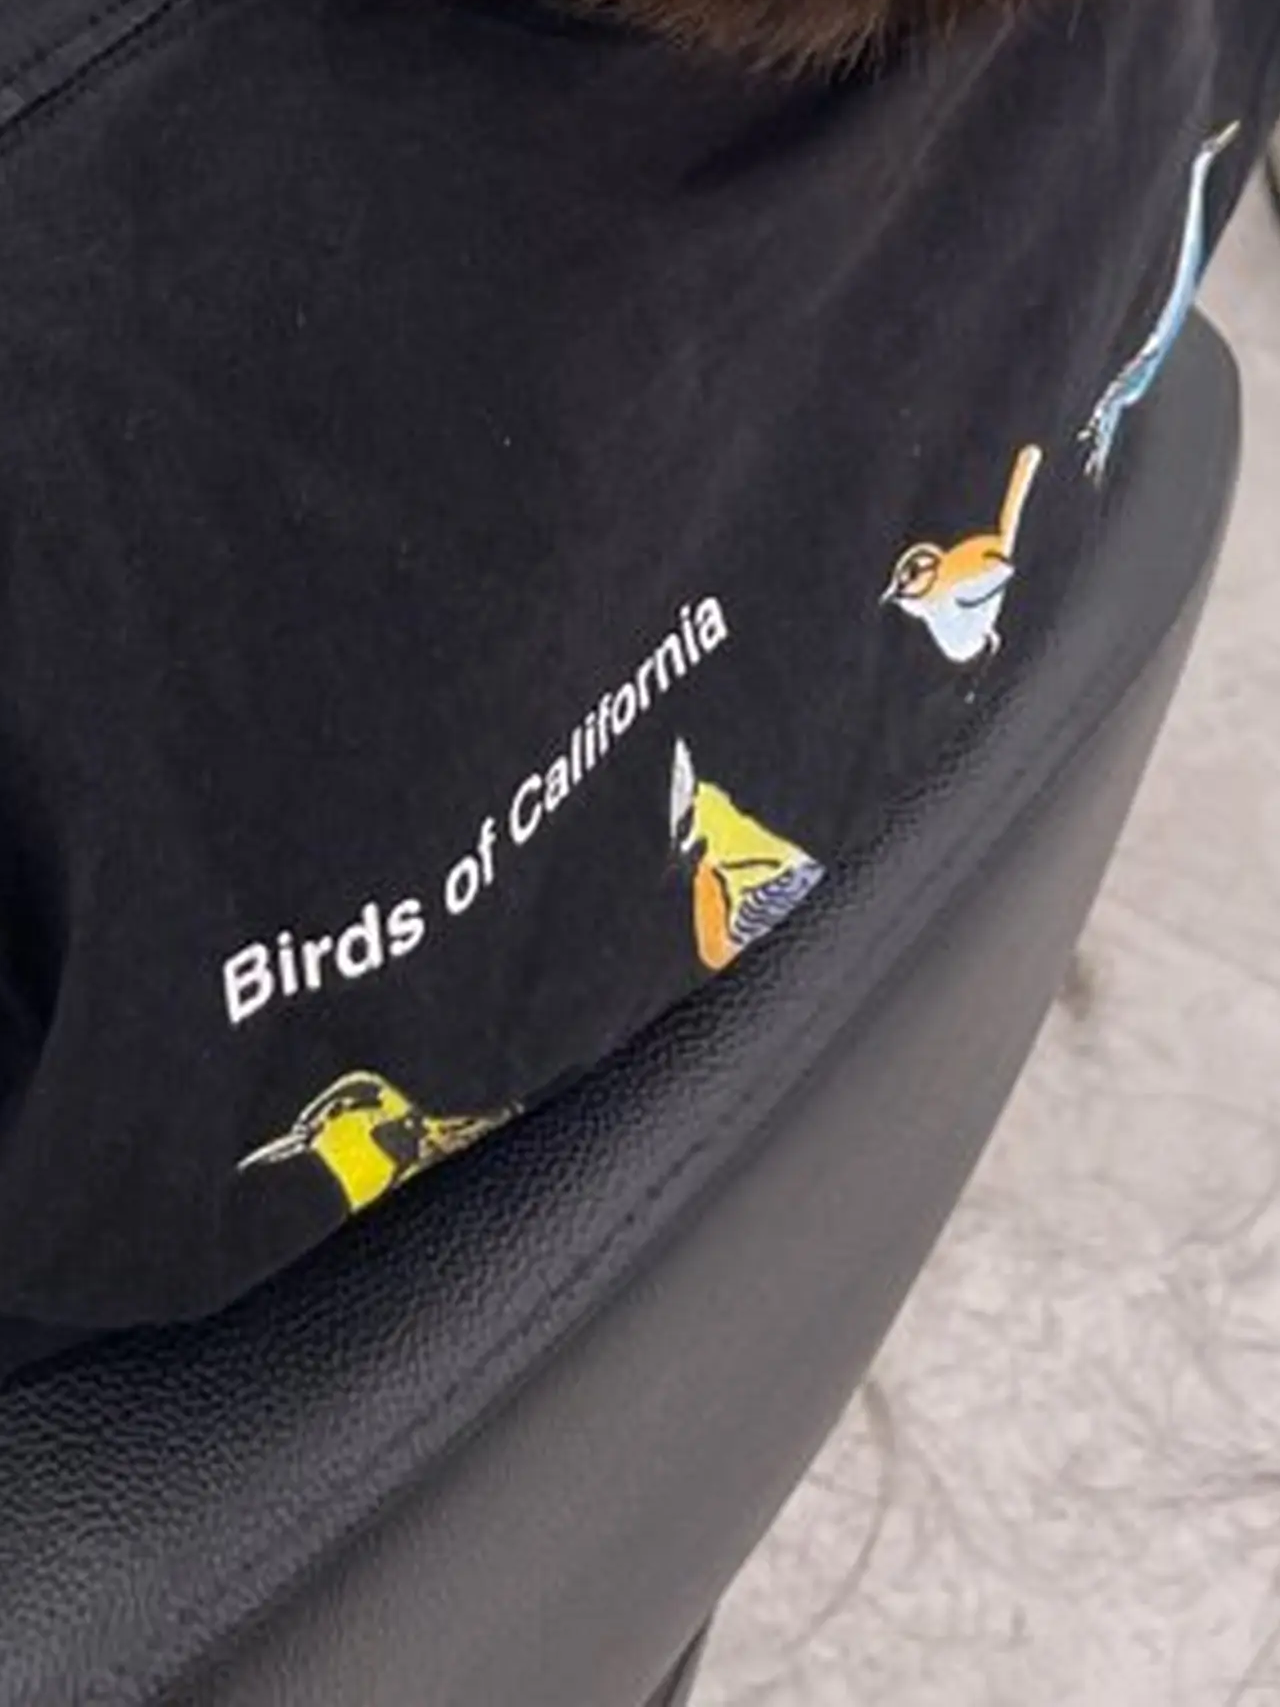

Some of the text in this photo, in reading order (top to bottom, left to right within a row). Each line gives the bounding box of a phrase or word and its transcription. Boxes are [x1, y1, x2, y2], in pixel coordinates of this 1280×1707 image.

[223, 596, 729, 1024] Birds of California
